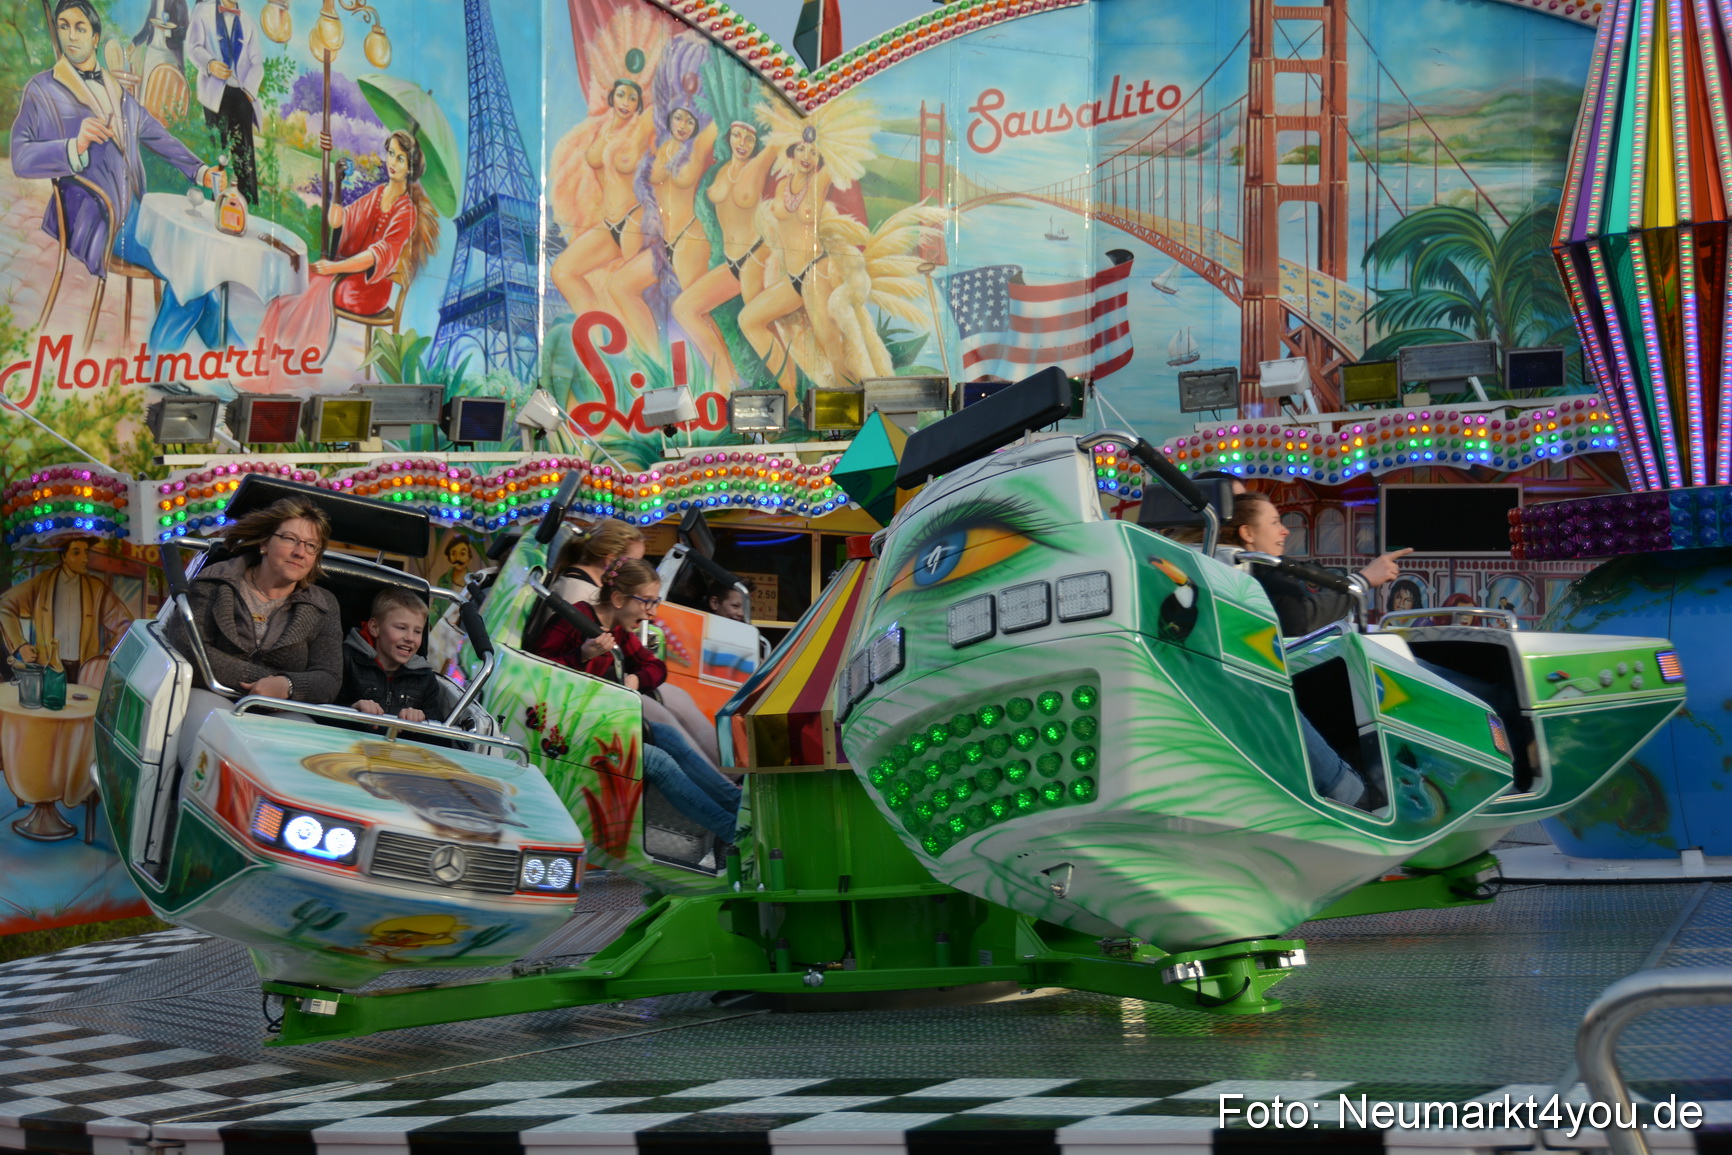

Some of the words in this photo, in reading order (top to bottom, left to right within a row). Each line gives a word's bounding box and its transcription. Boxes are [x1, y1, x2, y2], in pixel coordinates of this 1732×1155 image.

[966, 74, 1182, 155] Sausalito
[0, 334, 324, 411] Montmartre
[757, 590, 777, 600] 2.50
